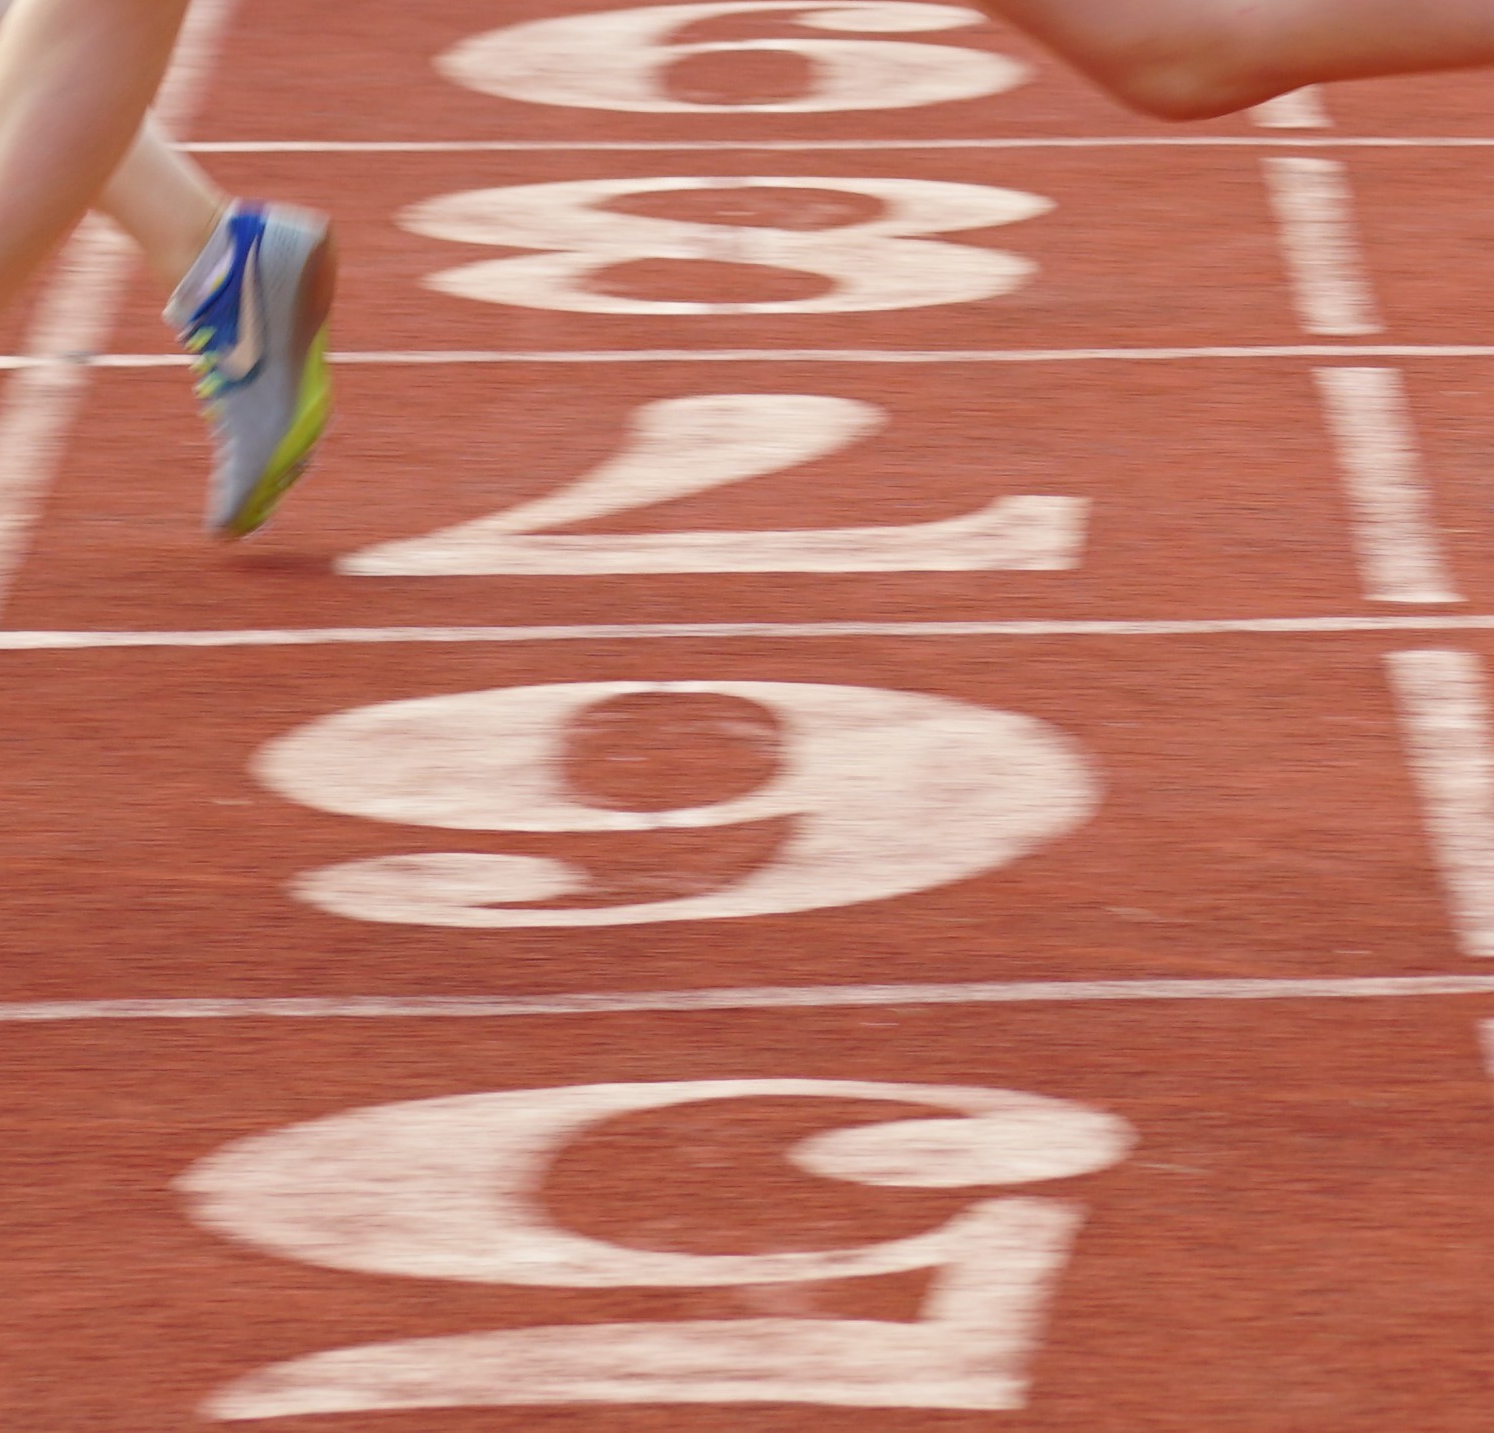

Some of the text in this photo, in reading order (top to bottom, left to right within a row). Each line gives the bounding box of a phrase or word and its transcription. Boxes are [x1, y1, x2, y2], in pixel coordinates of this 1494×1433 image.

[434, 0, 1037, 112] 9
[395, 175, 1060, 315] 8
[333, 393, 1091, 577] 7
[248, 679, 1104, 928] 6
[172, 1078, 1140, 1421] 5
